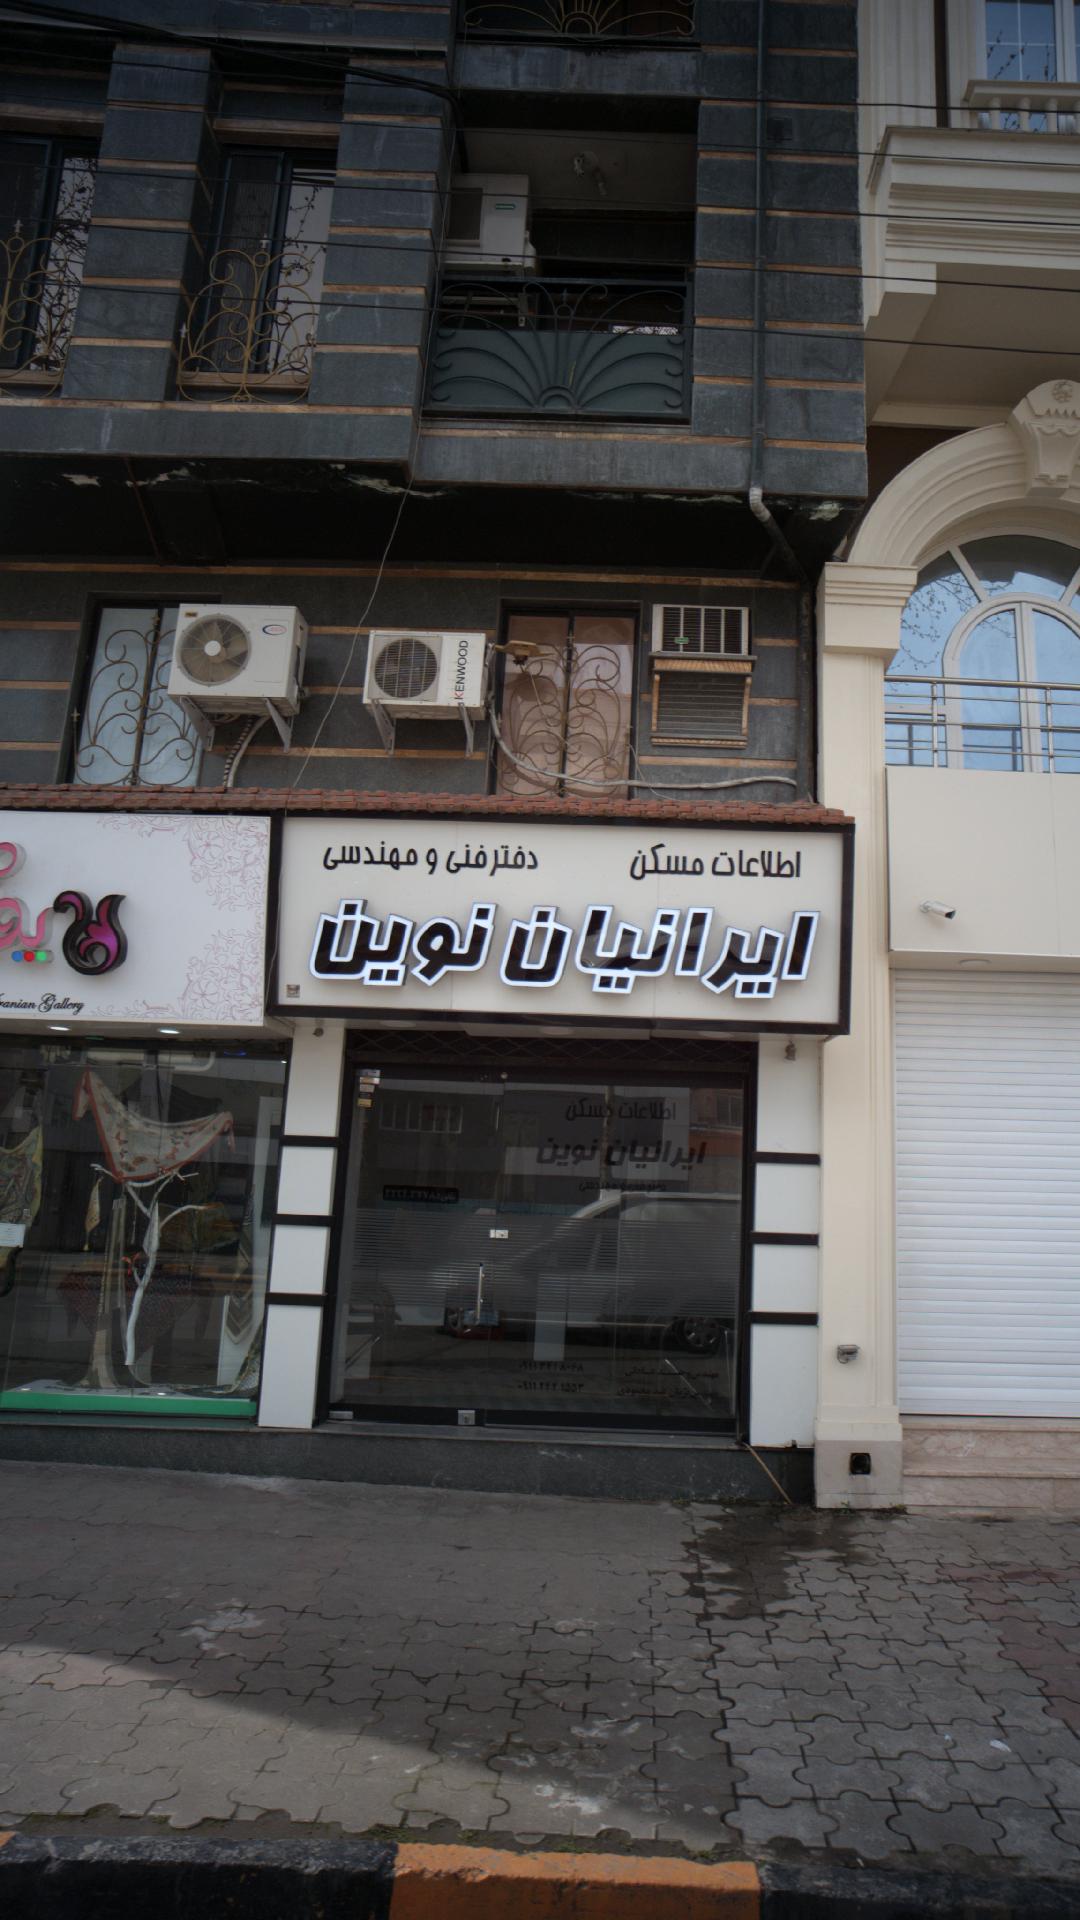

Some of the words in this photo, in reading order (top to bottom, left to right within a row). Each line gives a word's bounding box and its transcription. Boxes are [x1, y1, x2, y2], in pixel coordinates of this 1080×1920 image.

[454, 640, 469, 700] KENWOOD
[322, 840, 418, 871] مهندسی
[426, 848, 438, 875] و
[446, 844, 488, 874] فنی
[490, 845, 538, 877] دفتر
[630, 843, 704, 881] مسکن
[712, 850, 801, 878] اطلاعات
[308, 898, 499, 987] نوین
[500, 904, 821, 999] ایرانیان
[0, 992, 37, 1009] ranian
[38, 992, 85, 1016] Gallery
[566, 1097, 613, 1122] مسکن
[618, 1101, 677, 1121] اطلاعات
[536, 1137, 599, 1167] نوین
[605, 1138, 708, 1171] ایرانیان
